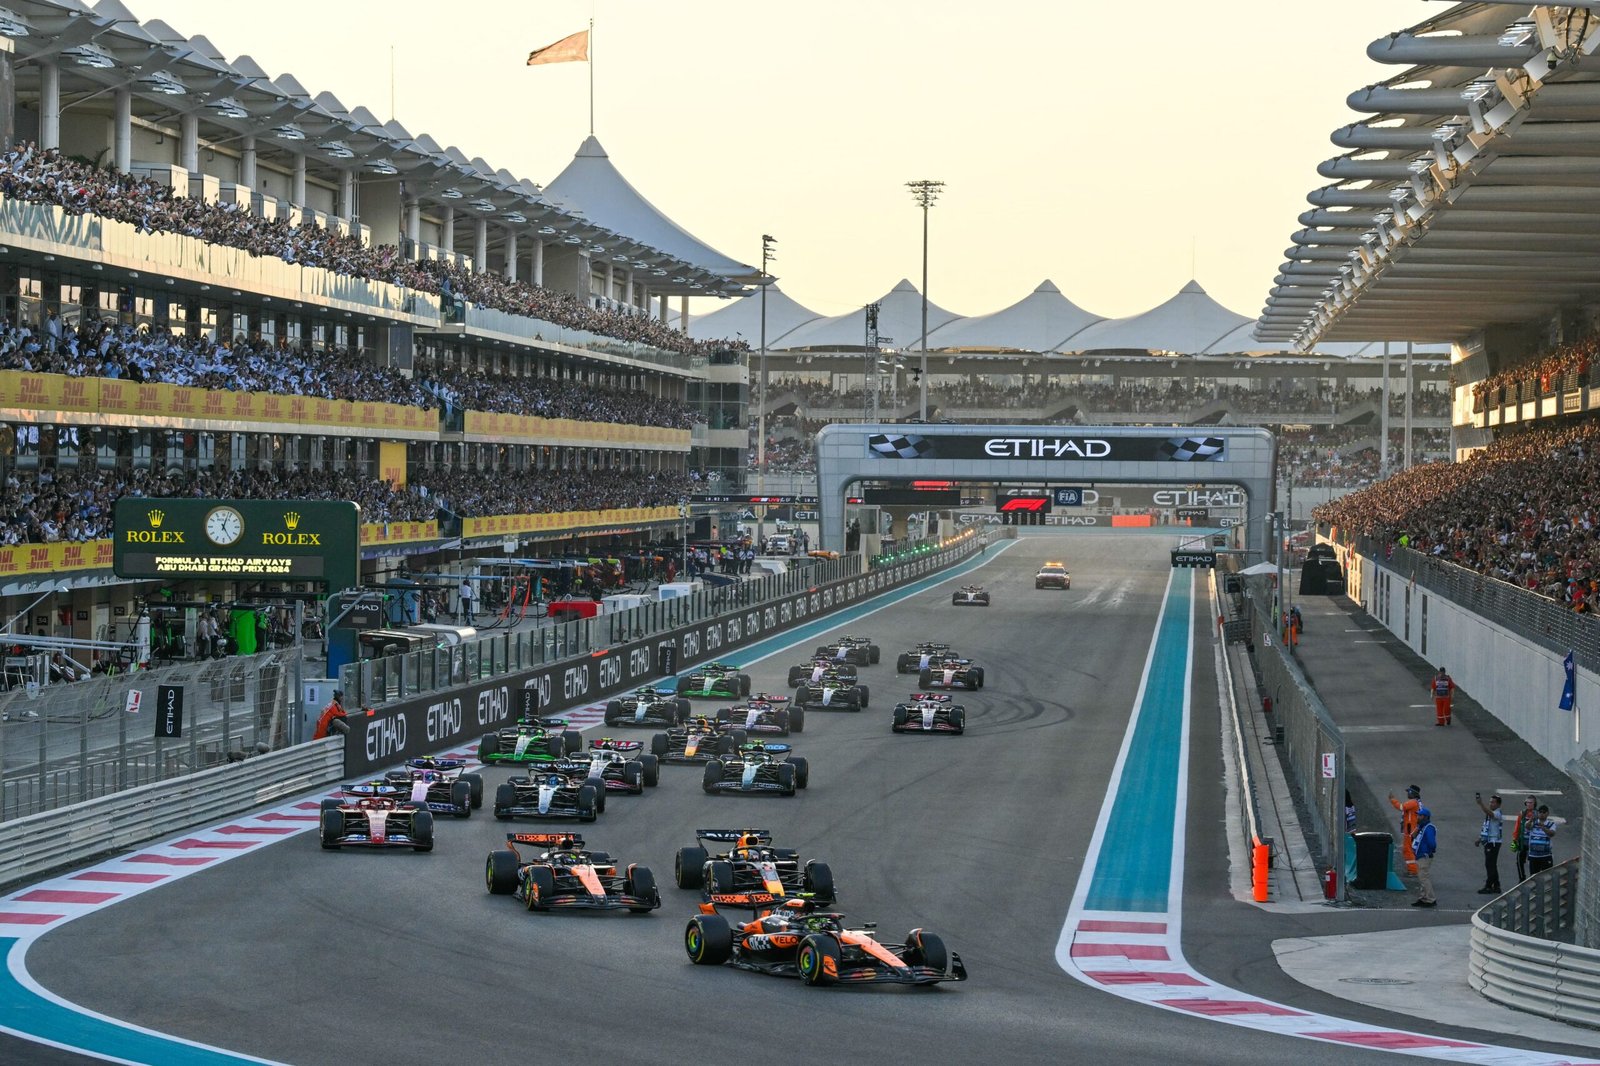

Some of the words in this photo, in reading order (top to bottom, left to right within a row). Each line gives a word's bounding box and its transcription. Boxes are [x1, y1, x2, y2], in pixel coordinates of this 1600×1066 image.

[17, 378, 45, 403] DHL
[60, 381, 86, 407] DHL
[100, 384, 125, 409] DHL
[984, 438, 1111, 458] ETIHAD
[795, 511, 819, 520] ETI
[127, 531, 185, 543] ROLEX
[262, 533, 321, 545] ROLEX
[155, 557, 201, 565] FORMULA
[210, 558, 245, 566] ETIHAD
[246, 558, 292, 566] AIRWAYS
[178, 564, 207, 572] DHABI
[242, 565, 265, 573] PRIX
[265, 565, 290, 573] 2024
[1176, 556, 1212, 565] ETIHAD
[342, 603, 379, 611] EIHAD
[683, 631, 700, 658] ETIHAD
[600, 656, 621, 689] ETIHAD
[630, 646, 650, 677] ETIHAD
[564, 665, 589, 699] ETIHAD
[166, 689, 175, 734] ETIHAD
[478, 686, 509, 726] ETIHAD
[427, 698, 462, 743] ETIHAD
[366, 713, 406, 761] ETIHAD
[775, 936, 797, 944] VELO
